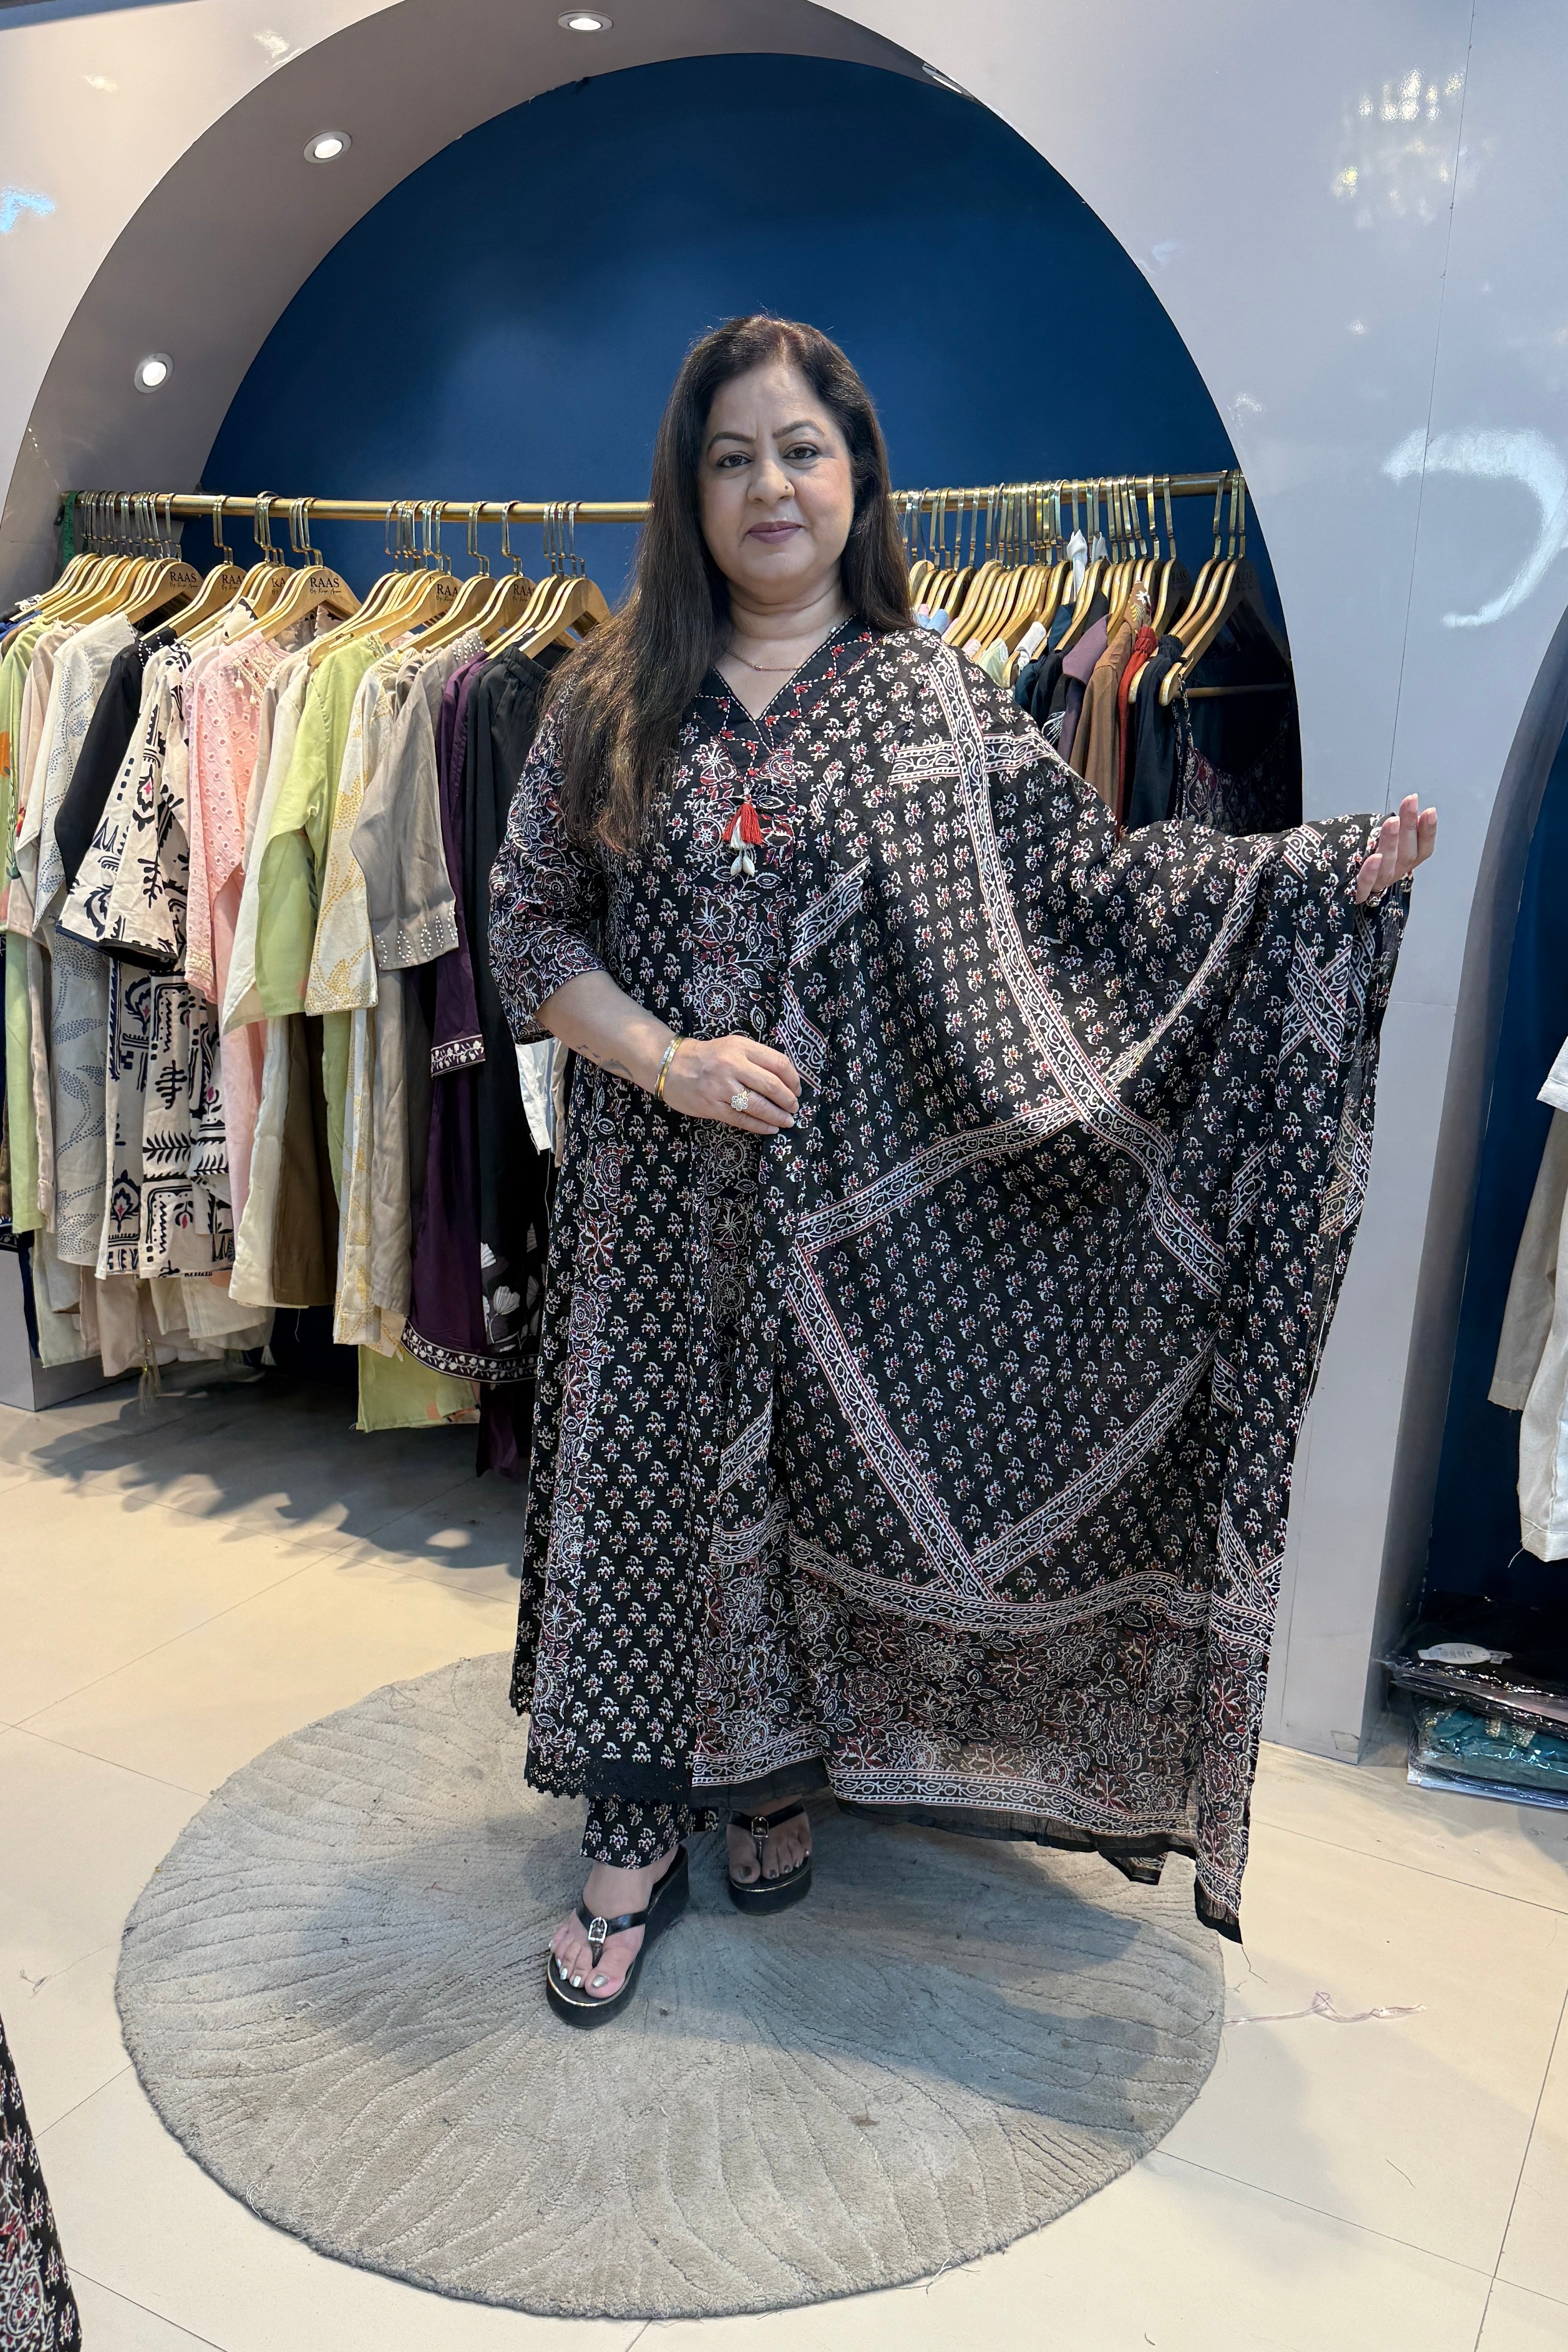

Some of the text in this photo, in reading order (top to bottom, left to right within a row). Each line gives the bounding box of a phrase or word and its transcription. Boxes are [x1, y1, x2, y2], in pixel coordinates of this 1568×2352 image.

[170, 572, 197, 583] RAAS
[222, 574, 244, 585] RAA
[272, 577, 285, 587] RA
[310, 577, 339, 588] RAAS
[437, 584, 458, 596] RAA
